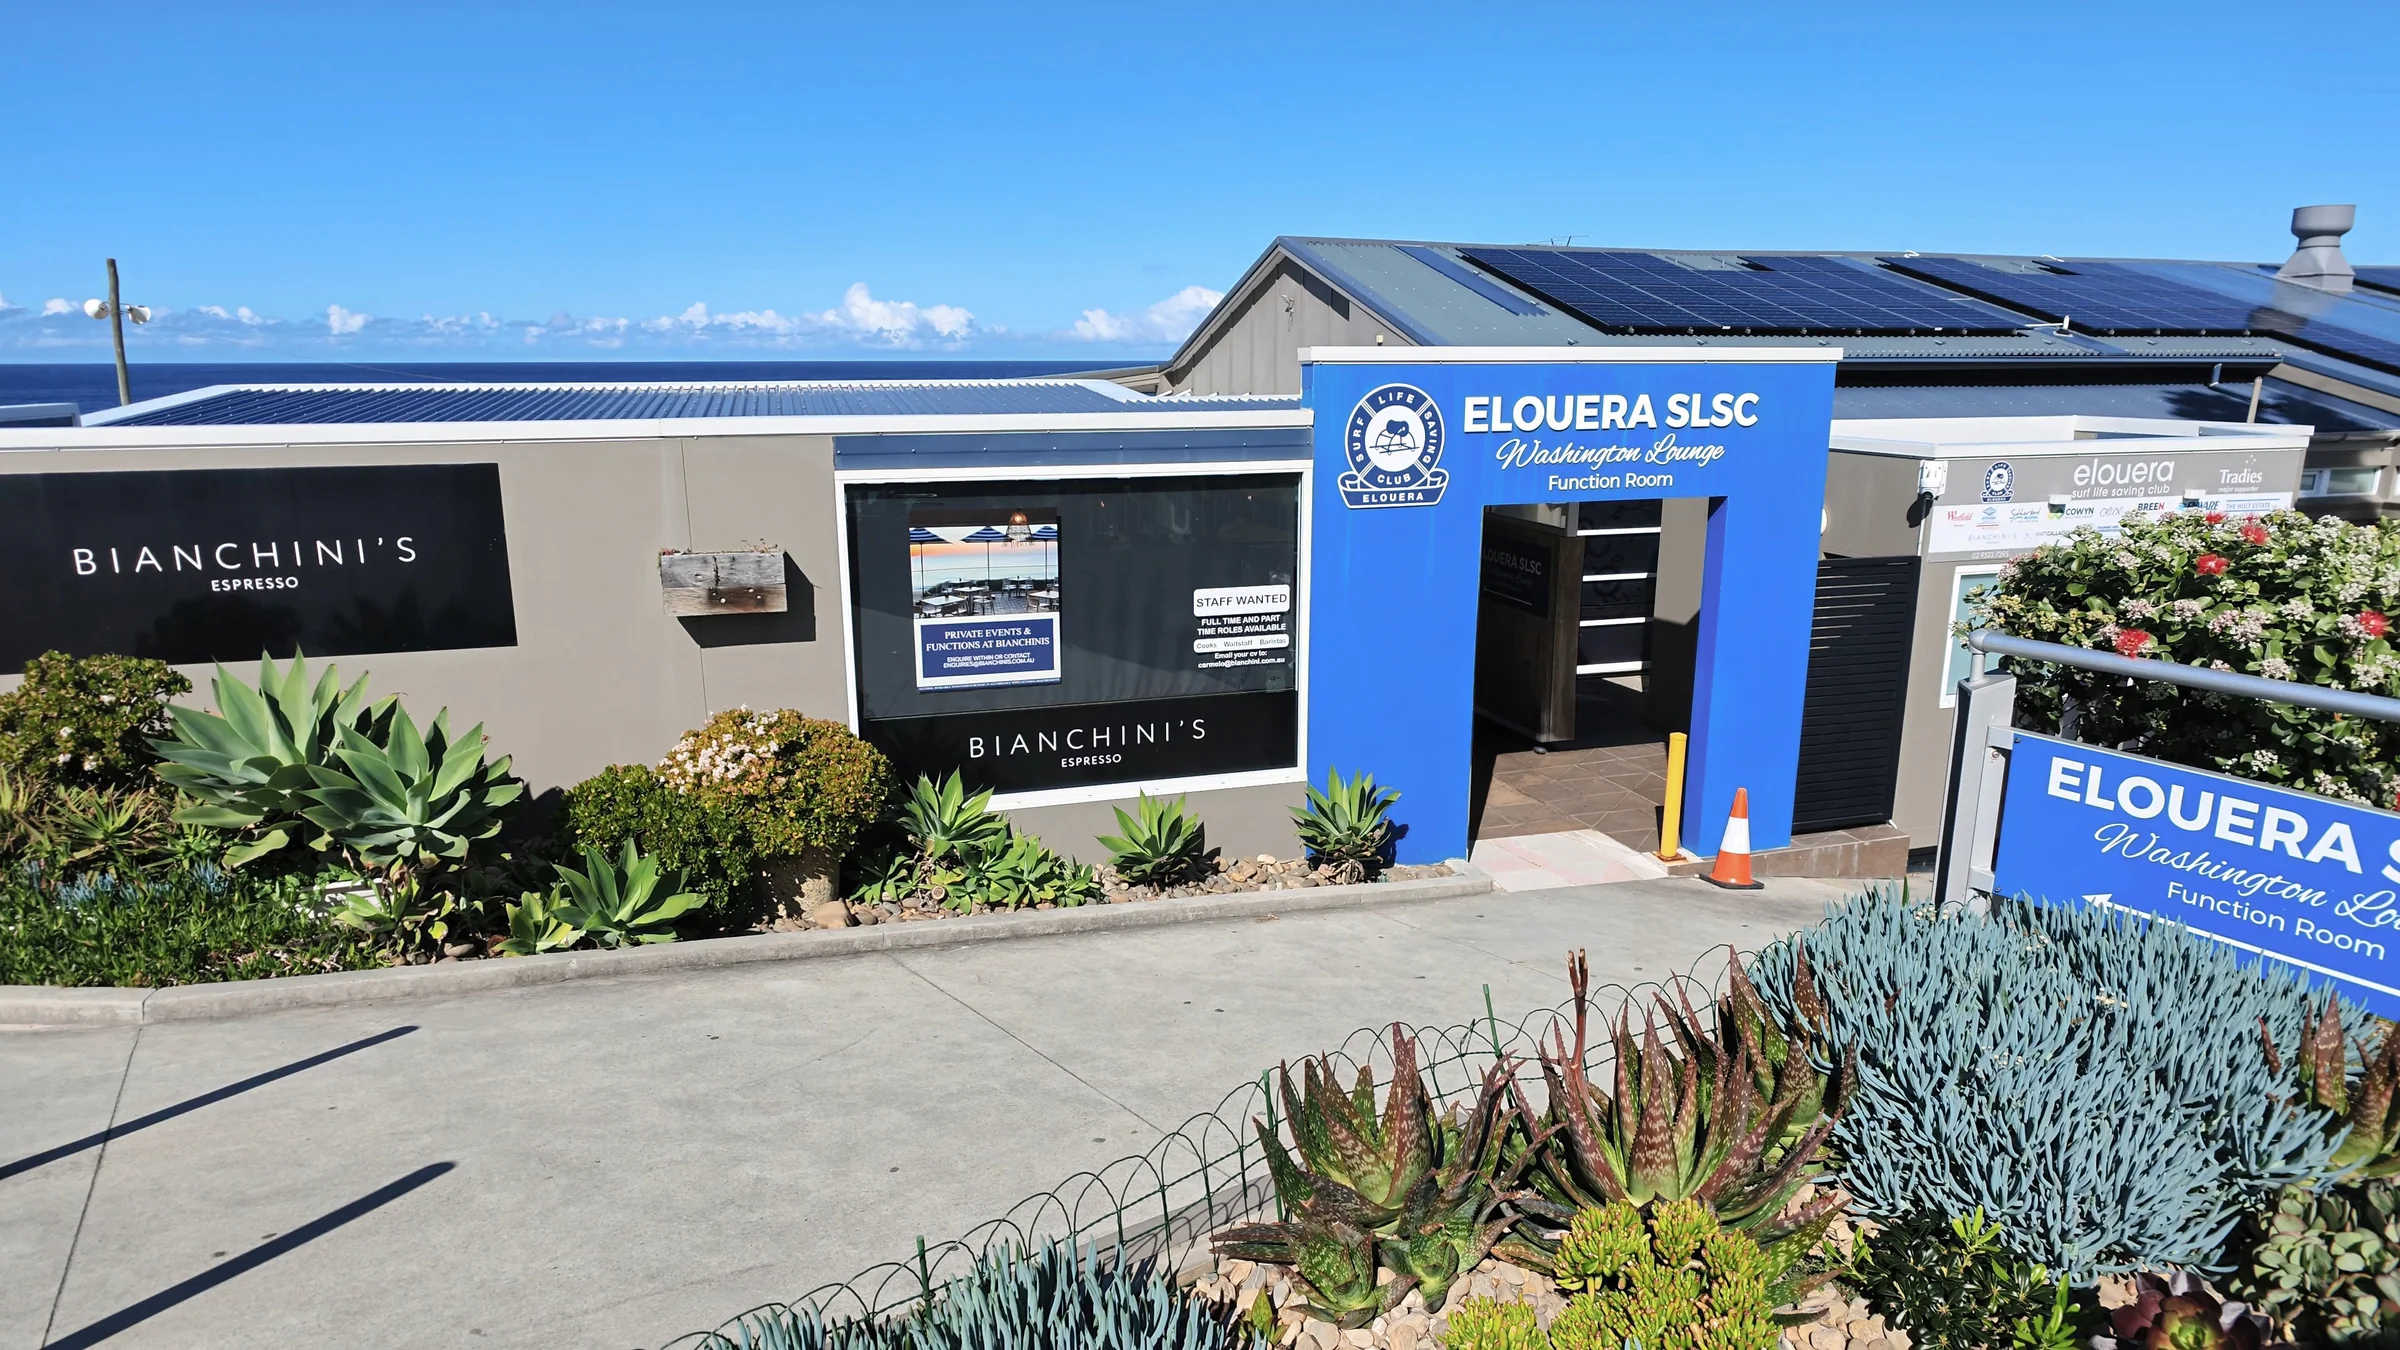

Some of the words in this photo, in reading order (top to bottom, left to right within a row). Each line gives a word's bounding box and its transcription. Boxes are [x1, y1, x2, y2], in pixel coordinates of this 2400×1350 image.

[1378, 392, 1415, 405] LIFE
[1463, 394, 1657, 433] ELOUERA
[1665, 392, 1760, 428] SLSC
[1352, 417, 1365, 462] SURF
[1422, 411, 1438, 464] SAVING
[1495, 438, 1641, 470] Washington
[1644, 433, 1725, 467] Lounge
[1377, 473, 1411, 485] CLUB
[2073, 458, 2175, 486] elouera
[2219, 468, 2263, 484] Tradies
[1548, 474, 1620, 491] Function
[1625, 472, 1673, 488] Room
[2234, 485, 2259, 493] supporter
[1362, 492, 1424, 503] ELOUERA
[2071, 488, 2091, 498] surf
[2093, 486, 2109, 497] life
[2111, 485, 2145, 497] saving
[2148, 484, 2170, 495] club
[2066, 507, 2095, 516] COWYN
[2137, 502, 2165, 511] BREEN
[73, 537, 417, 576] BIANCHINI'S
[1483, 547, 1518, 569] LOUERA
[1519, 557, 1542, 575] SLSC
[211, 576, 299, 592] ESPRESSO
[1196, 596, 1233, 608] STAFF
[1235, 593, 1288, 606] WANTED
[1201, 618, 1221, 626] FULL
[1223, 616, 1242, 625] TIME
[1242, 615, 1260, 623] AND
[1260, 614, 1281, 622] PART
[945, 629, 983, 639] PRIVATE
[985, 627, 1022, 638] EVENTS
[1023, 627, 1031, 635] &
[1197, 627, 1216, 636] TIME
[1217, 625, 1243, 634] ROLES
[1244, 623, 1287, 633] AVAILABLE
[926, 640, 981, 651] FUNCTIONS
[982, 640, 994, 648] AT
[996, 637, 1050, 648] BIANCHINIS
[1223, 640, 1253, 648] Waitstaff
[1259, 638, 1287, 646] Baristas
[947, 655, 973, 663] ENQUIRE
[1004, 652, 1031, 660] CONTACT
[1233, 651, 1249, 660] your
[969, 719, 1206, 758] BIANCHINI'S
[1061, 753, 1122, 768] ESPRESSO
[2047, 756, 2364, 875] ELOUERA
[2094, 823, 2327, 908] Washington
[2167, 880, 2286, 931] Function
[2294, 917, 2386, 961] Room
